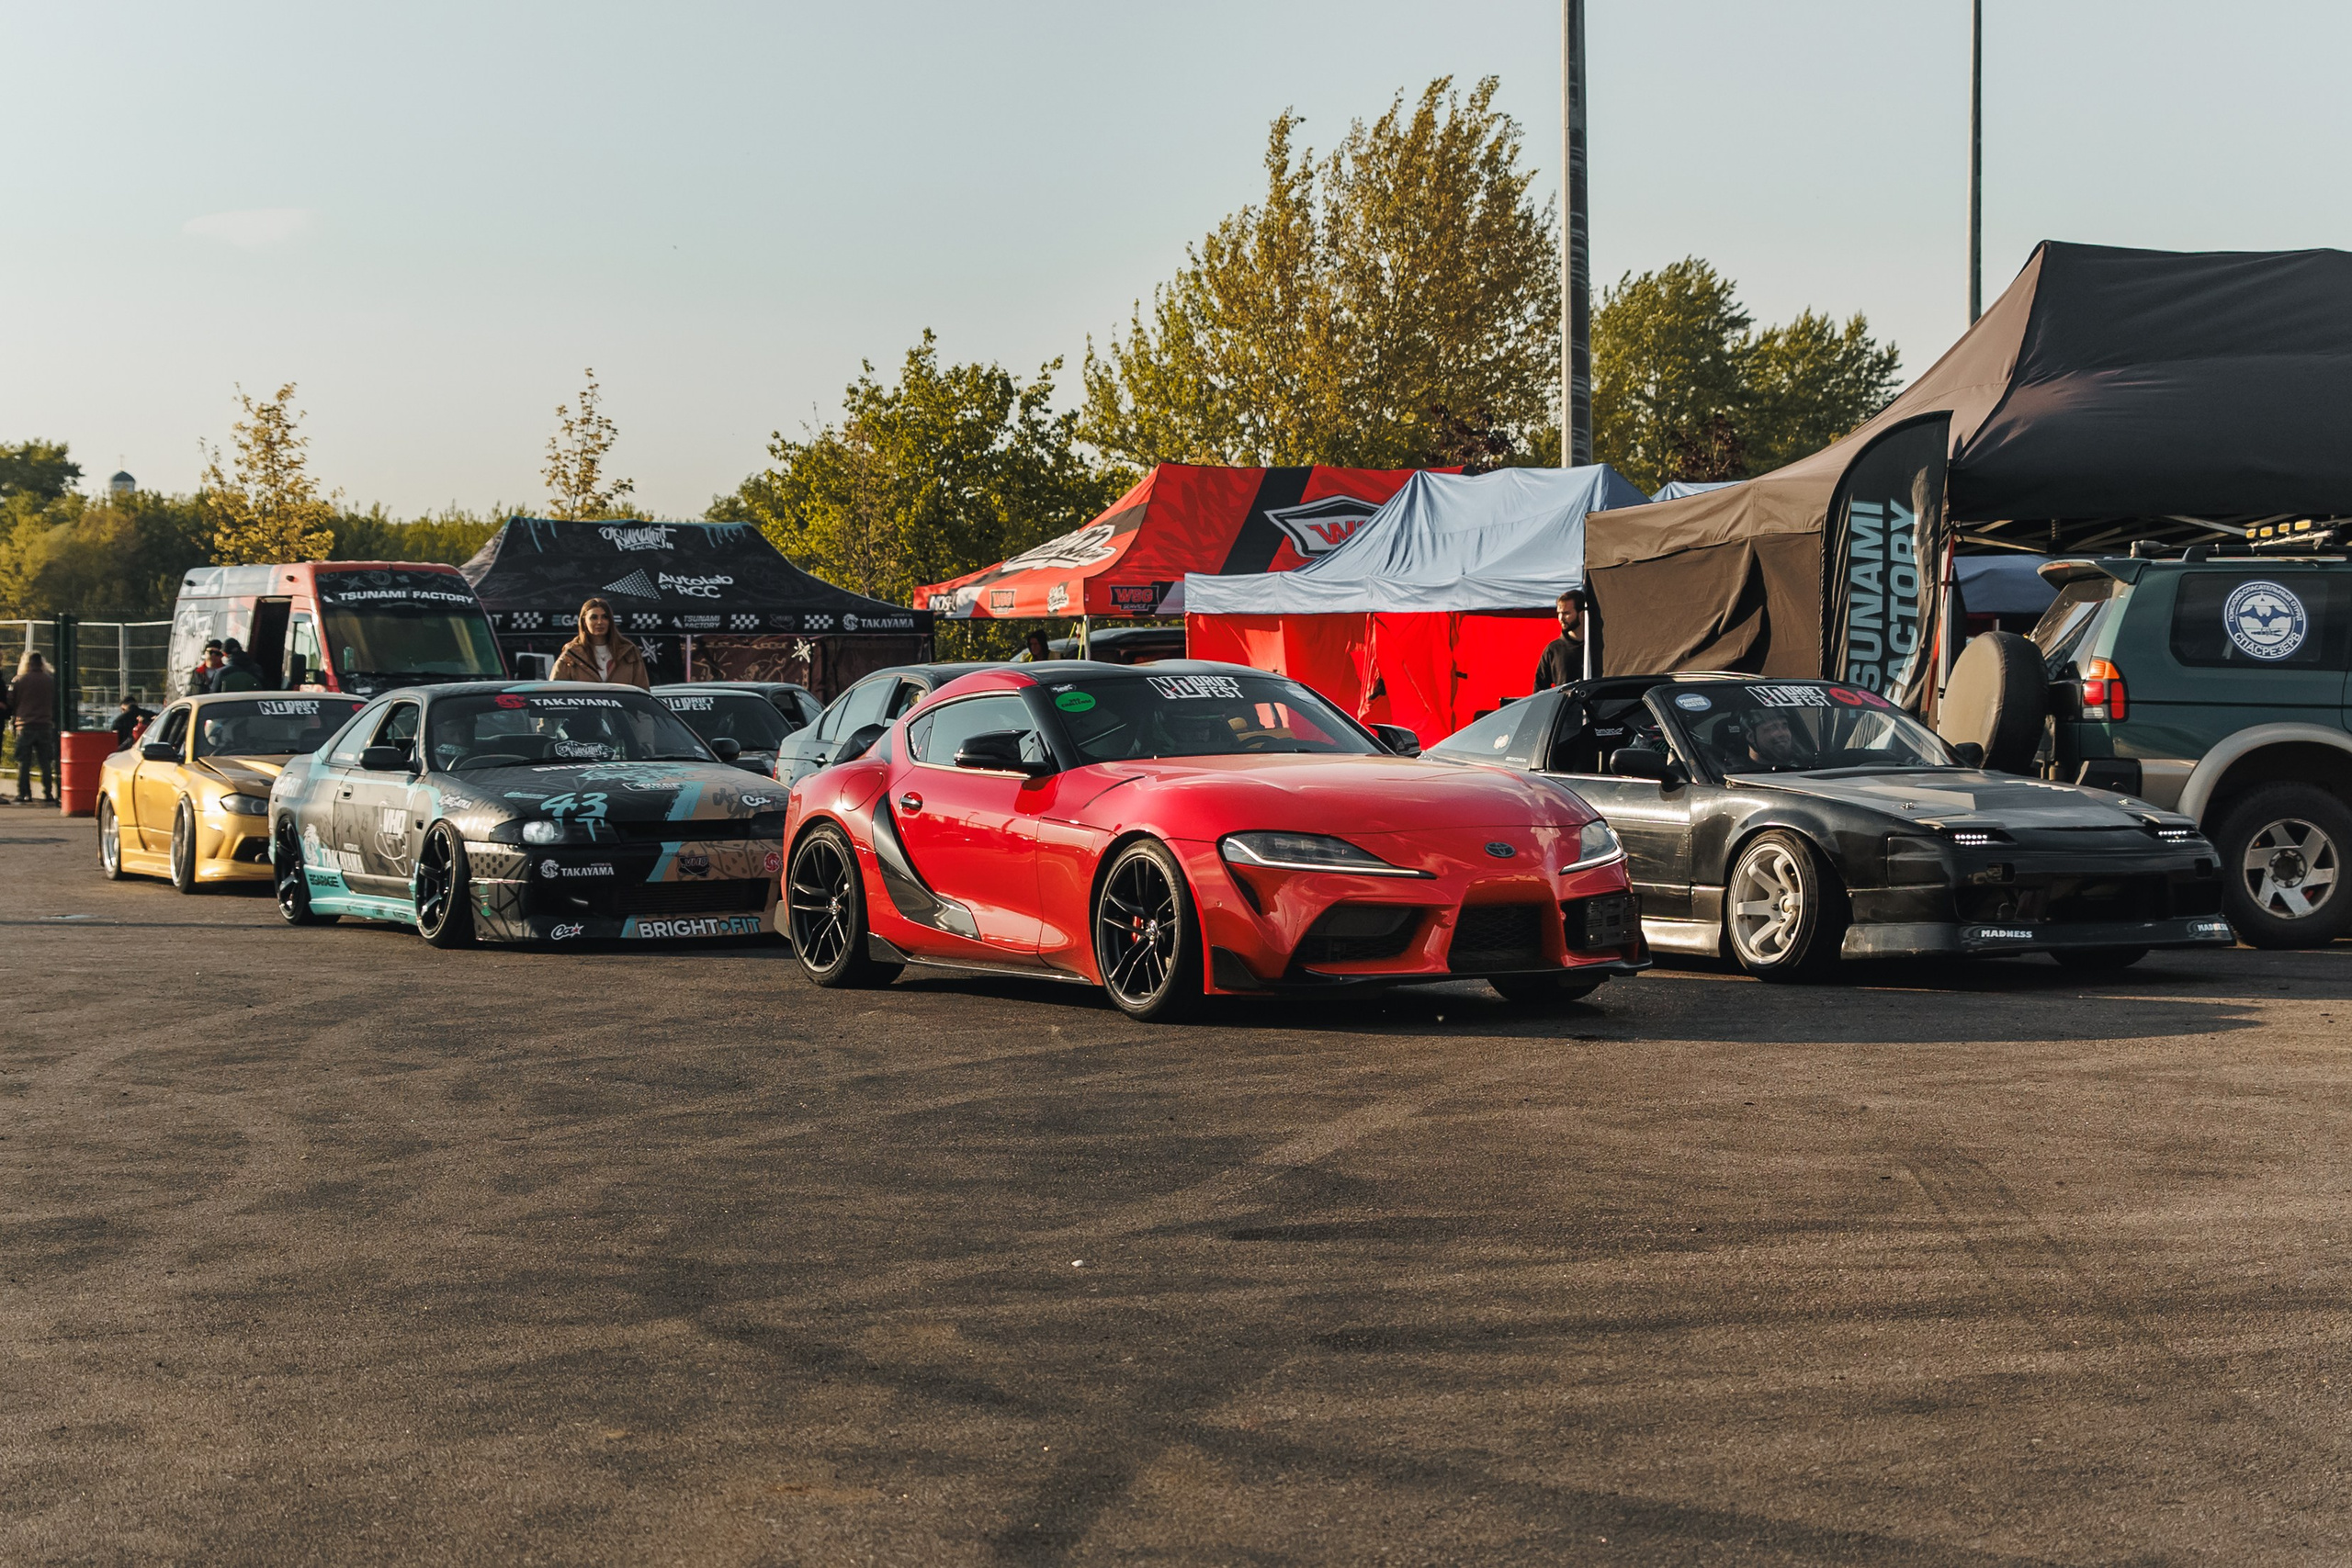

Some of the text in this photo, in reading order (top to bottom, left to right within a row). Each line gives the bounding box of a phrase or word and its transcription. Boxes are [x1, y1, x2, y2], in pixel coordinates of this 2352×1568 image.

[658, 571, 733, 586] Autolab
[338, 591, 473, 604] TSUNAMI FACTORY
[674, 584, 721, 599] RCC
[1114, 588, 1153, 603] WSG
[1849, 501, 1883, 693] SUNAMI
[860, 618, 914, 628] TAKAYAMA
[2233, 632, 2301, 656] СПАСРЕЗЕРВ
[1187, 675, 1239, 688] DRIFT
[1199, 687, 1244, 698] FEST
[1780, 685, 1826, 697] DRIFT
[530, 698, 623, 707] TAKAYAMA
[1792, 695, 1831, 706] FEST
[540, 792, 608, 821] 43
[320, 848, 366, 874] TAKAYAMA
[560, 866, 615, 876] TAKAYAMA
[1981, 930, 2032, 938] MADNESS
